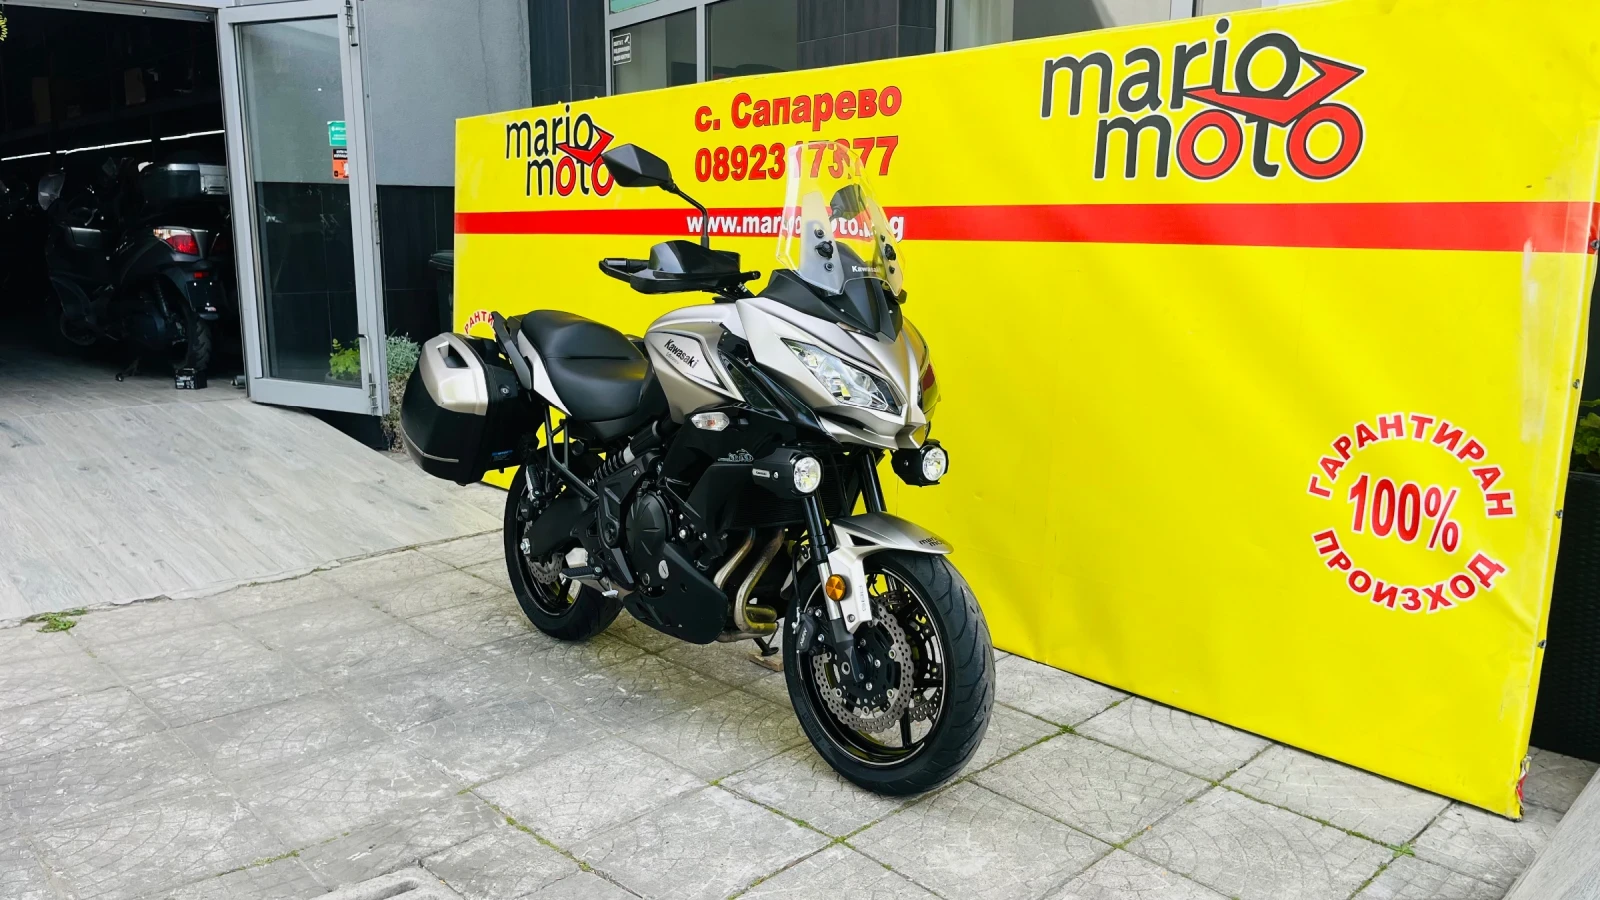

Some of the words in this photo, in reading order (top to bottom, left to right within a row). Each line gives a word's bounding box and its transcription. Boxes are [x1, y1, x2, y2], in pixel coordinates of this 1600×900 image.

[1041, 18, 1301, 117] mario
[506, 104, 594, 159] mario
[695, 106, 721, 131] с.
[731, 84, 903, 132] Сапарево
[1093, 102, 1364, 181] moto
[526, 154, 615, 197] moto
[664, 339, 700, 369] Kawasaki
[1308, 414, 1514, 517] ГАРАНТИРАН
[1348, 474, 1460, 553] 100%
[1313, 529, 1506, 611] ПРОИЗХОД
